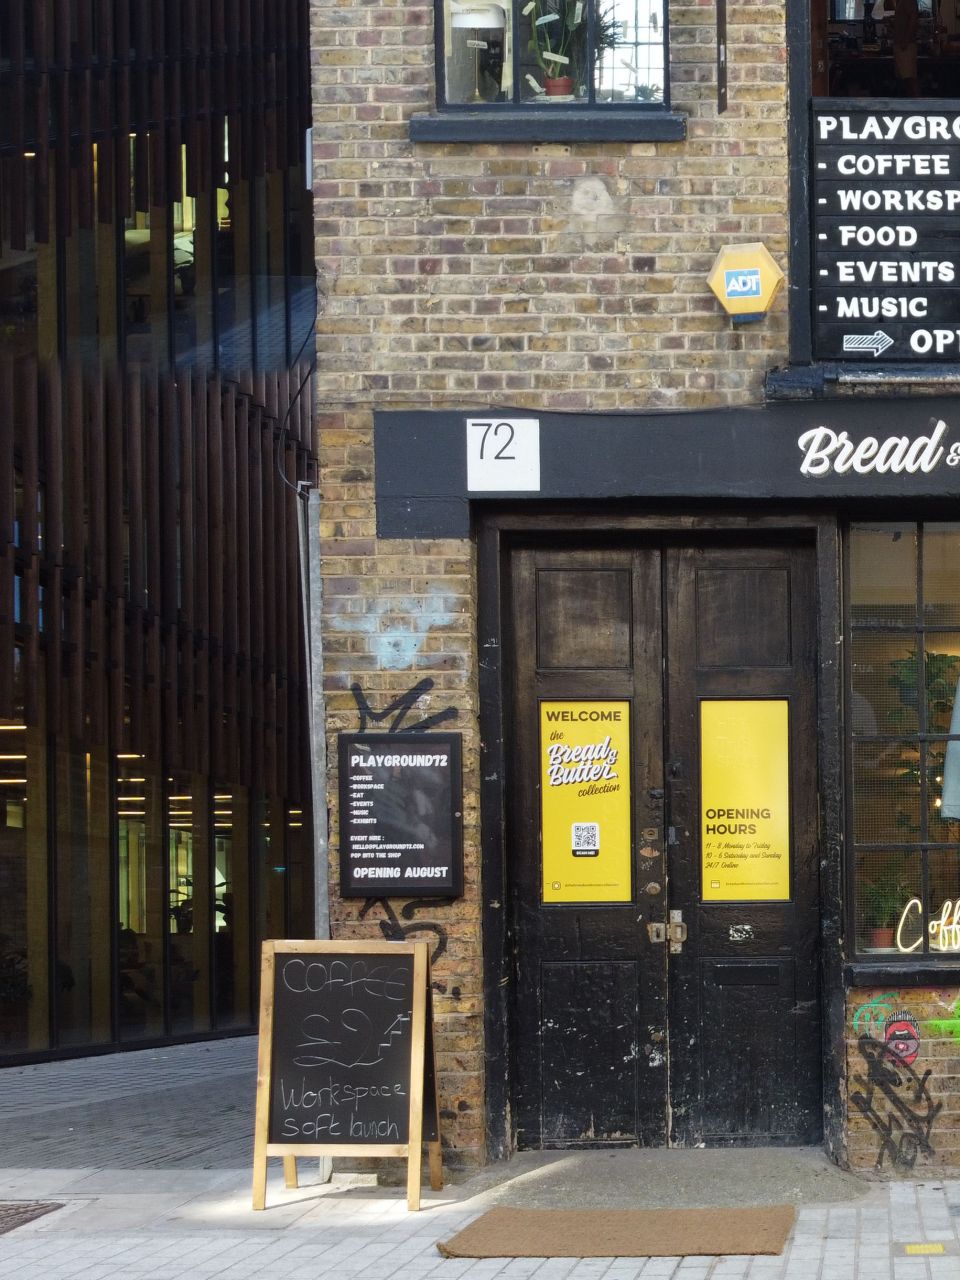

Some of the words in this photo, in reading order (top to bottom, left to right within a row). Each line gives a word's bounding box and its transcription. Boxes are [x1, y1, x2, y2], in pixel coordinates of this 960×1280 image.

[837, 154, 950, 175] COFFEE
[838, 225, 918, 246] FOOD
[836, 261, 955, 283] EVENTS
[727, 274, 760, 293] ADT
[836, 296, 928, 318] MUSIC
[471, 423, 516, 460] 72
[798, 419, 948, 476] Bread
[546, 710, 622, 722] WELCOME
[549, 730, 564, 741] the
[351, 754, 448, 767] PLAYGROUND72
[548, 736, 611, 766] Bread
[548, 761, 619, 787] Butter
[578, 783, 621, 797] collection
[705, 808, 771, 820] OPENING
[706, 823, 757, 835] HOURS
[353, 867, 401, 878] OPENING
[404, 866, 449, 878] AUGUST
[280, 1076, 408, 1111] Workspace
